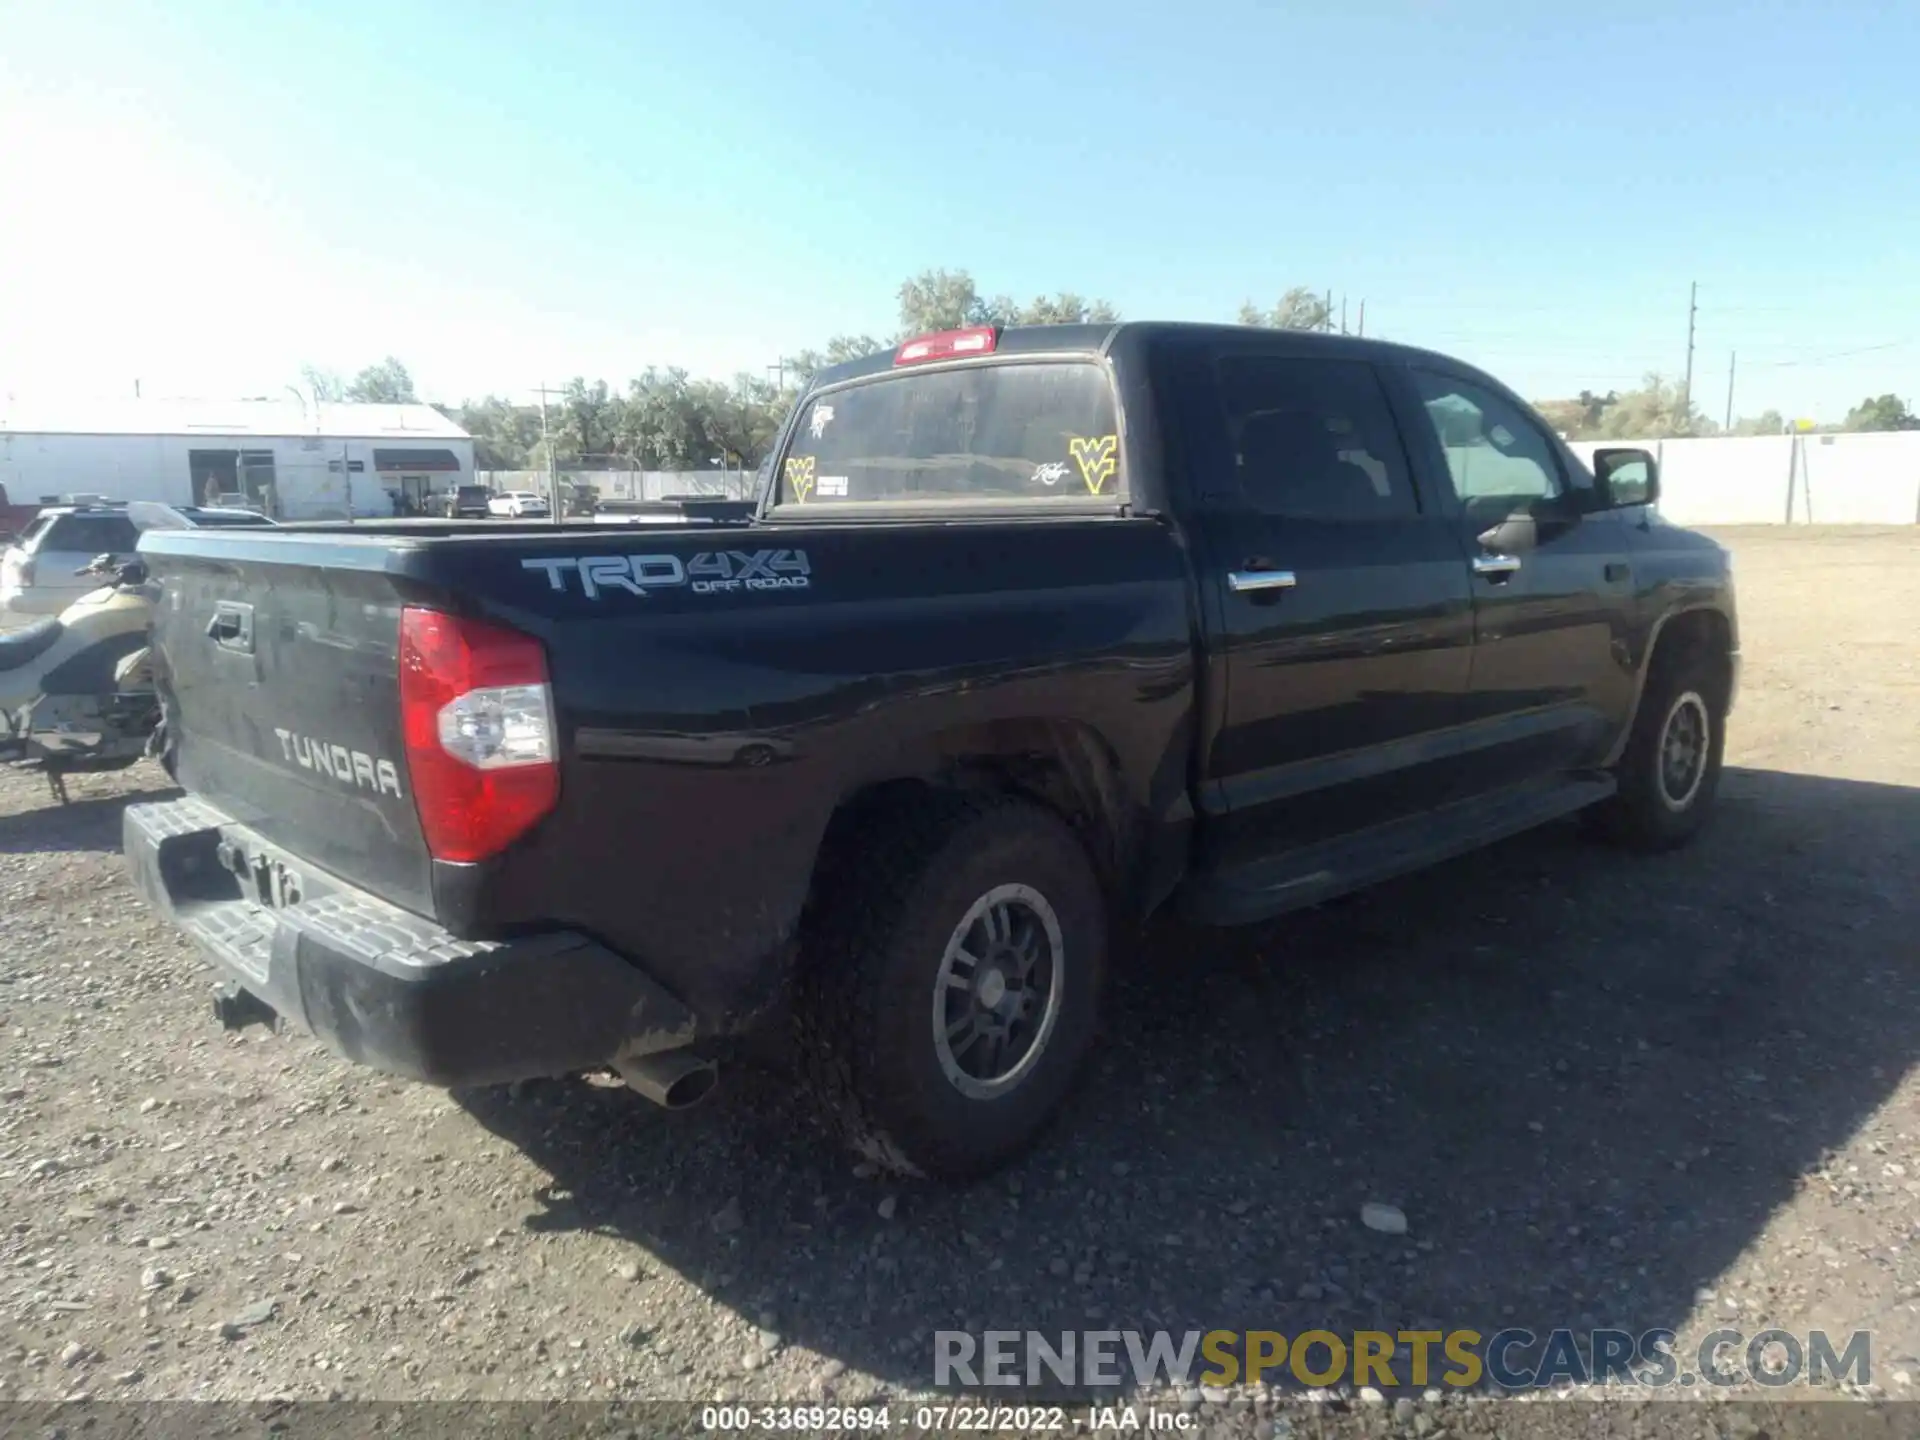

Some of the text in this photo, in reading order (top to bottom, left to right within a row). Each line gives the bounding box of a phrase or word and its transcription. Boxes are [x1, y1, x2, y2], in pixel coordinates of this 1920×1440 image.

[521, 554, 688, 599] TRD
[692, 576, 809, 593] OFF ROAD
[274, 727, 402, 799] TUNDRA
